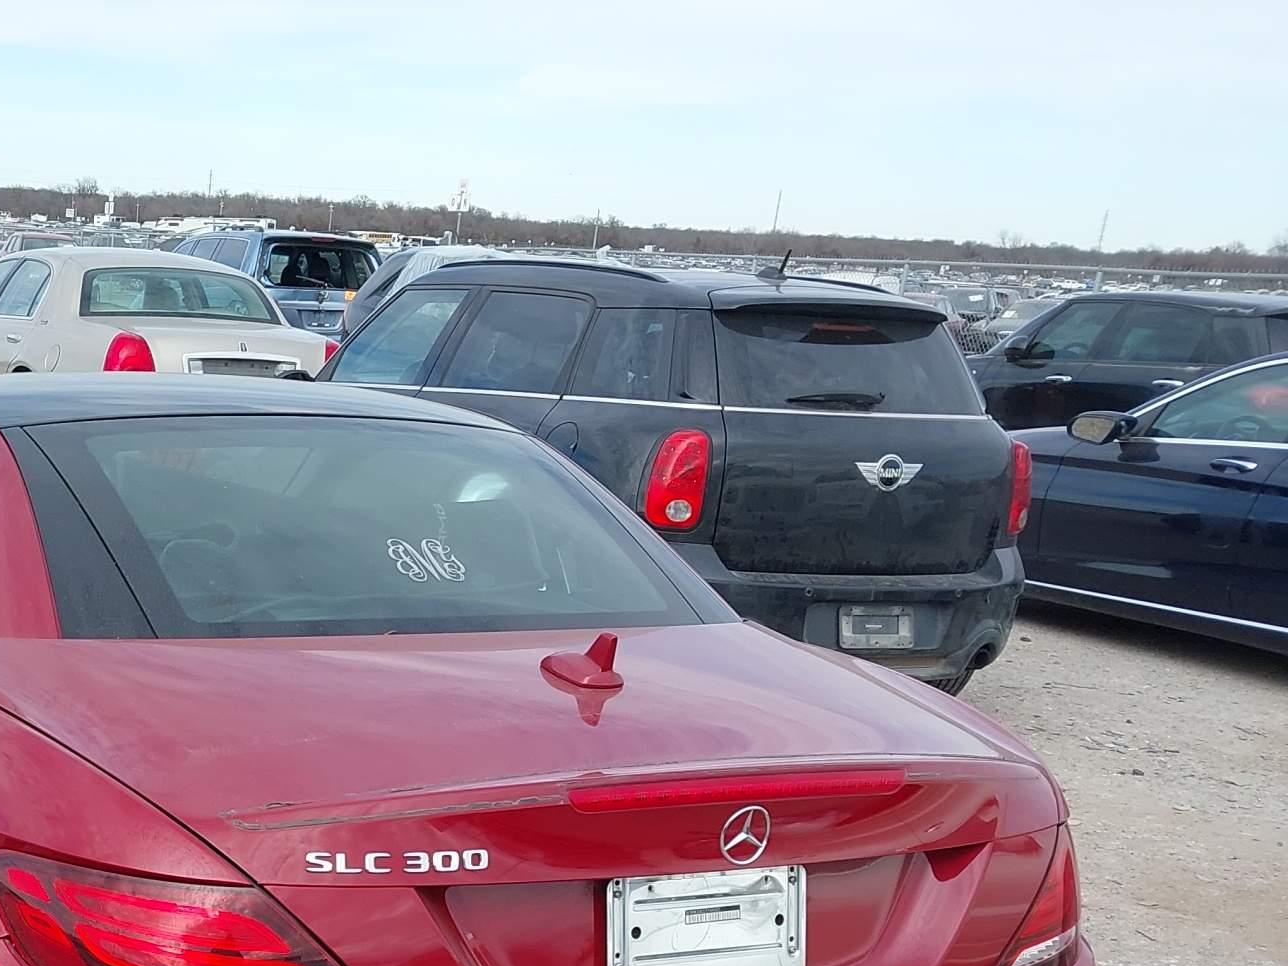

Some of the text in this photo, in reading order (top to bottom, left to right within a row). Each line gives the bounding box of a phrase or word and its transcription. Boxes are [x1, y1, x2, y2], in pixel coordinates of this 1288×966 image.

[878, 467, 902, 478] MINI
[305, 848, 490, 874] SLC 300
